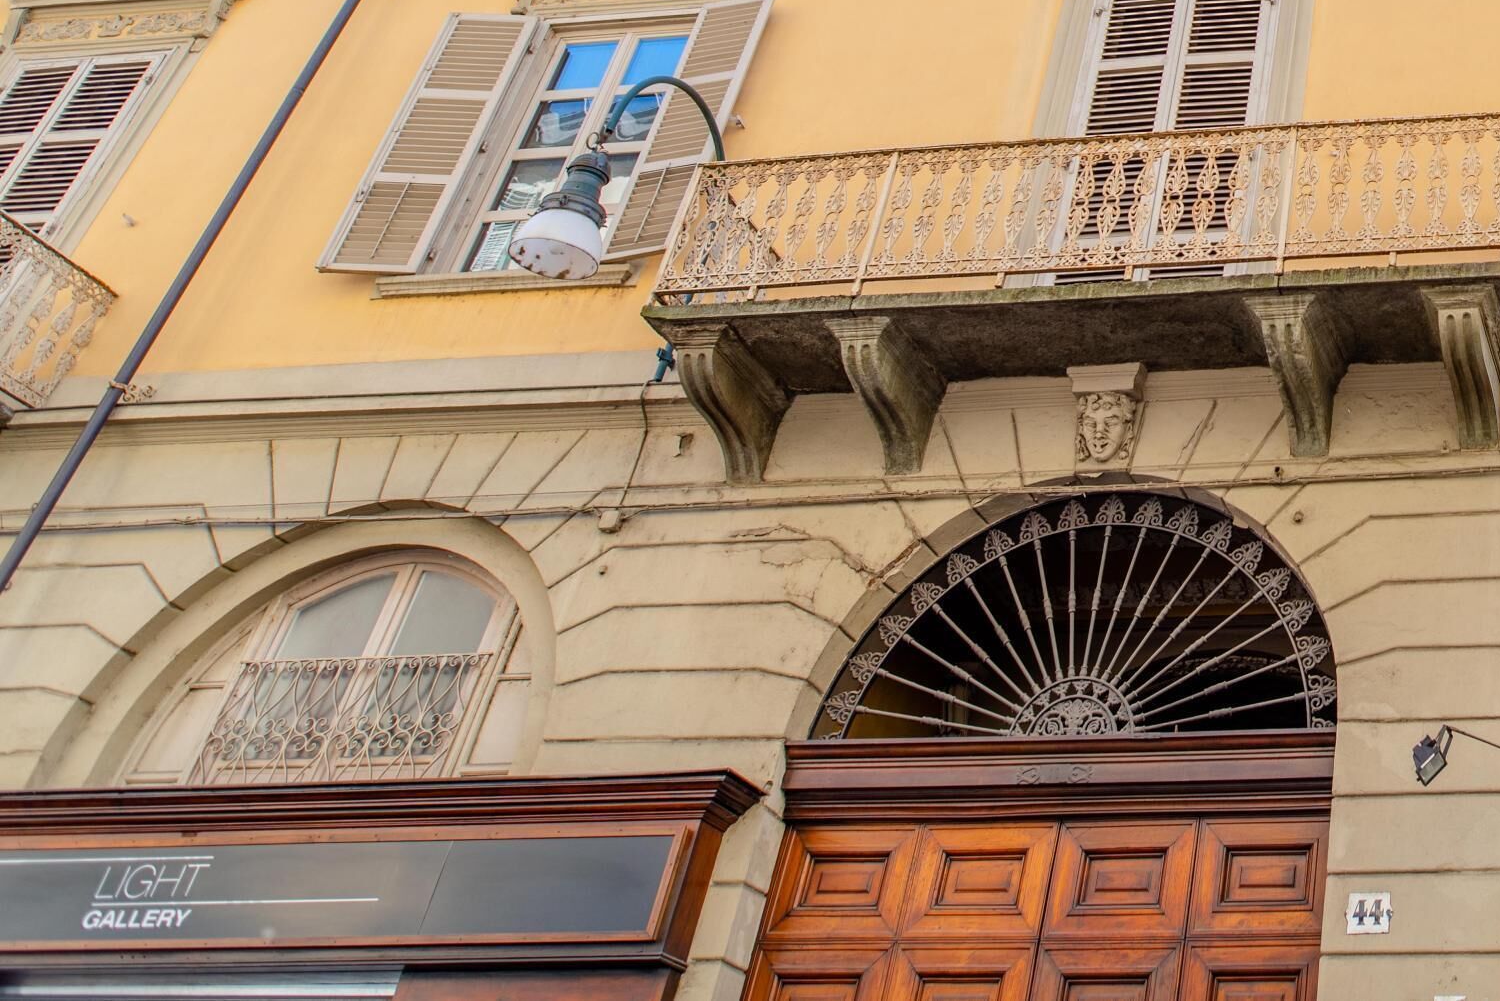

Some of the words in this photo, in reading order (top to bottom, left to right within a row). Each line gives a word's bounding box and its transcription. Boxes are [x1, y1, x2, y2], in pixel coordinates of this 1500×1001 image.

[94, 863, 211, 899] LIGHT
[82, 908, 192, 929] GALLERY
[1352, 899, 1385, 925] 44
